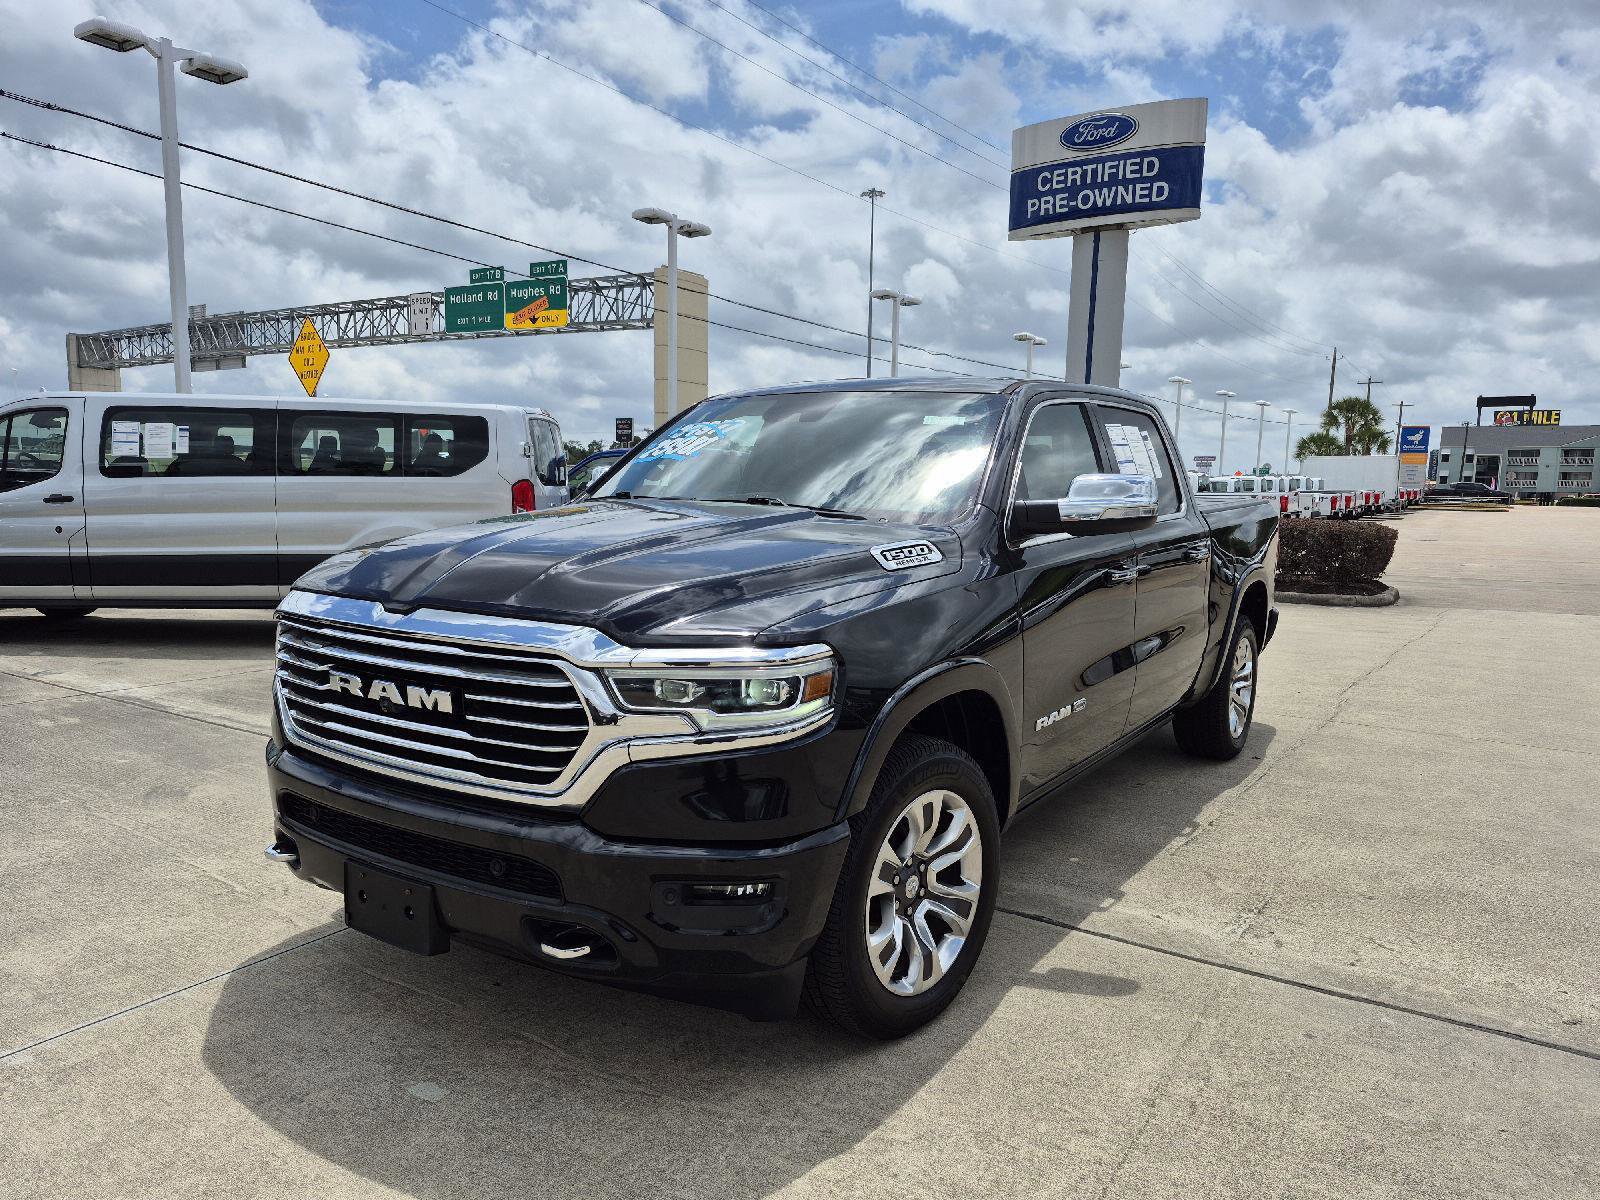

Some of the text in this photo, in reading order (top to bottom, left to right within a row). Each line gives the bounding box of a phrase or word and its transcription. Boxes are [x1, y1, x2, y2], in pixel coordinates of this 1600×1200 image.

[1074, 118, 1119, 143] Ford
[1037, 156, 1160, 192] CERTIFIED
[1027, 181, 1170, 219] PRE-OWNED
[450, 290, 498, 304] Holland Rd
[510, 285, 561, 299] Hughes Rd
[541, 313, 560, 323] ONLY
[883, 545, 929, 561] 1500
[328, 669, 453, 714] RAM
[1035, 704, 1072, 732] RAM
